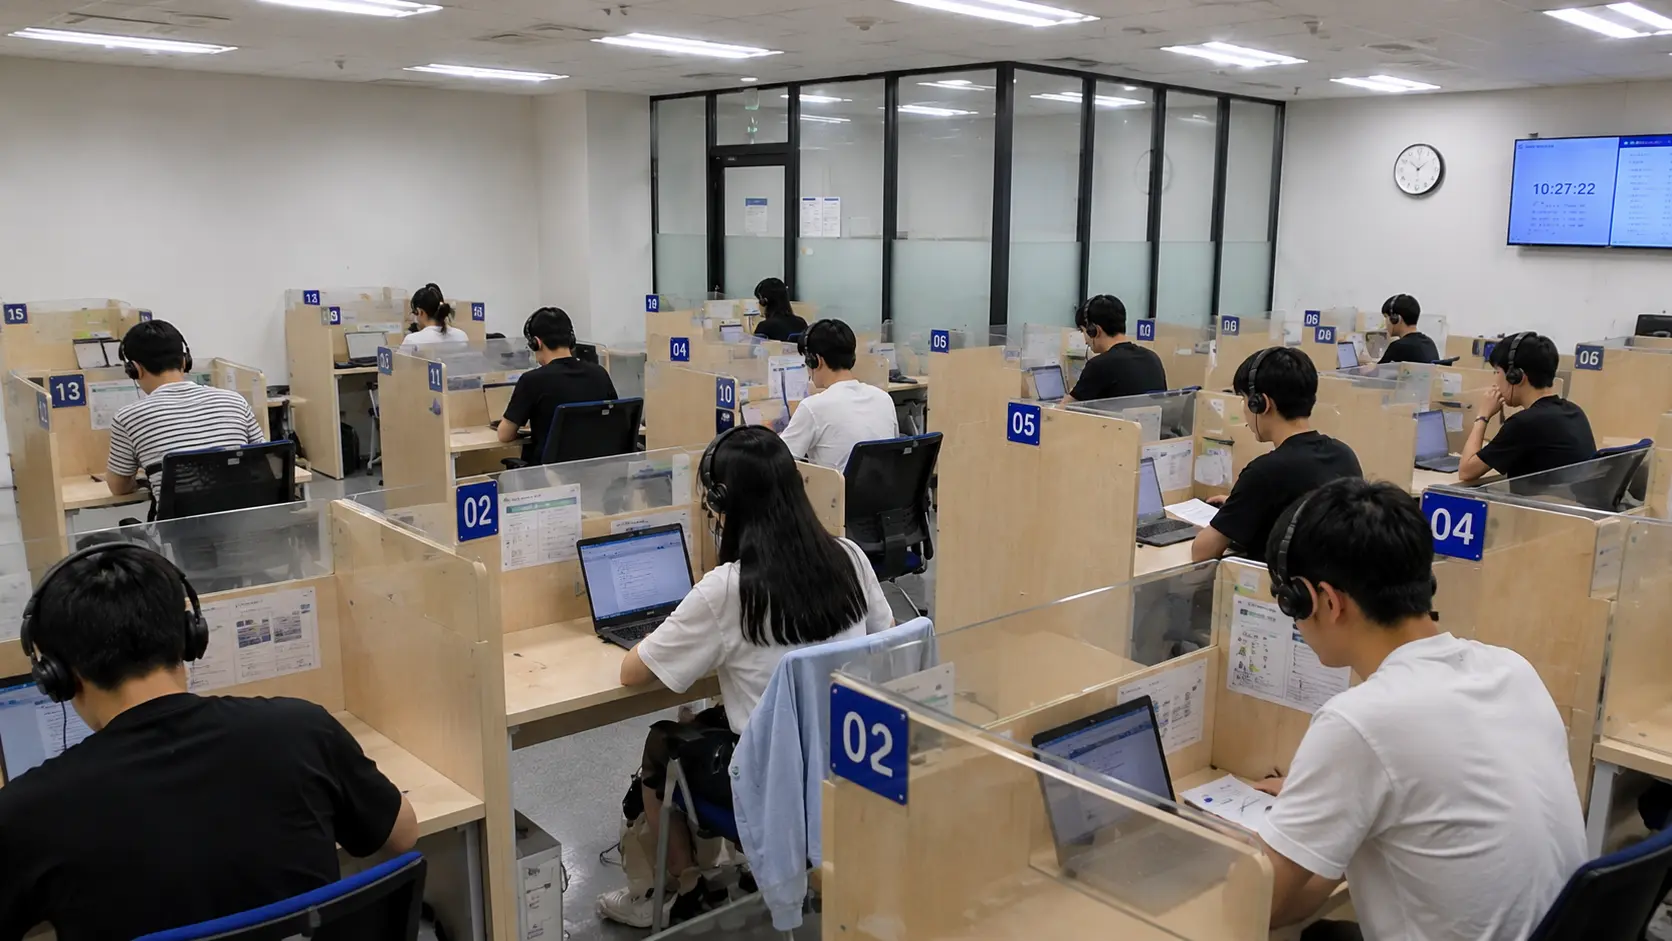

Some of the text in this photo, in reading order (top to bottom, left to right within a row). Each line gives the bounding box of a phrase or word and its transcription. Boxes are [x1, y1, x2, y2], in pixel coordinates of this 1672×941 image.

[1533, 182, 1596, 195] 10:27:22
[8, 308, 24, 321] 15
[673, 343, 686, 357] 04
[933, 334, 947, 348] 06
[1580, 350, 1600, 365] 06
[430, 368, 440, 386] 11
[56, 382, 80, 401] 13
[719, 383, 732, 403] 10
[1013, 411, 1035, 436] 05
[464, 494, 492, 528] 02
[1431, 507, 1475, 546] 04
[842, 711, 894, 779] 02
